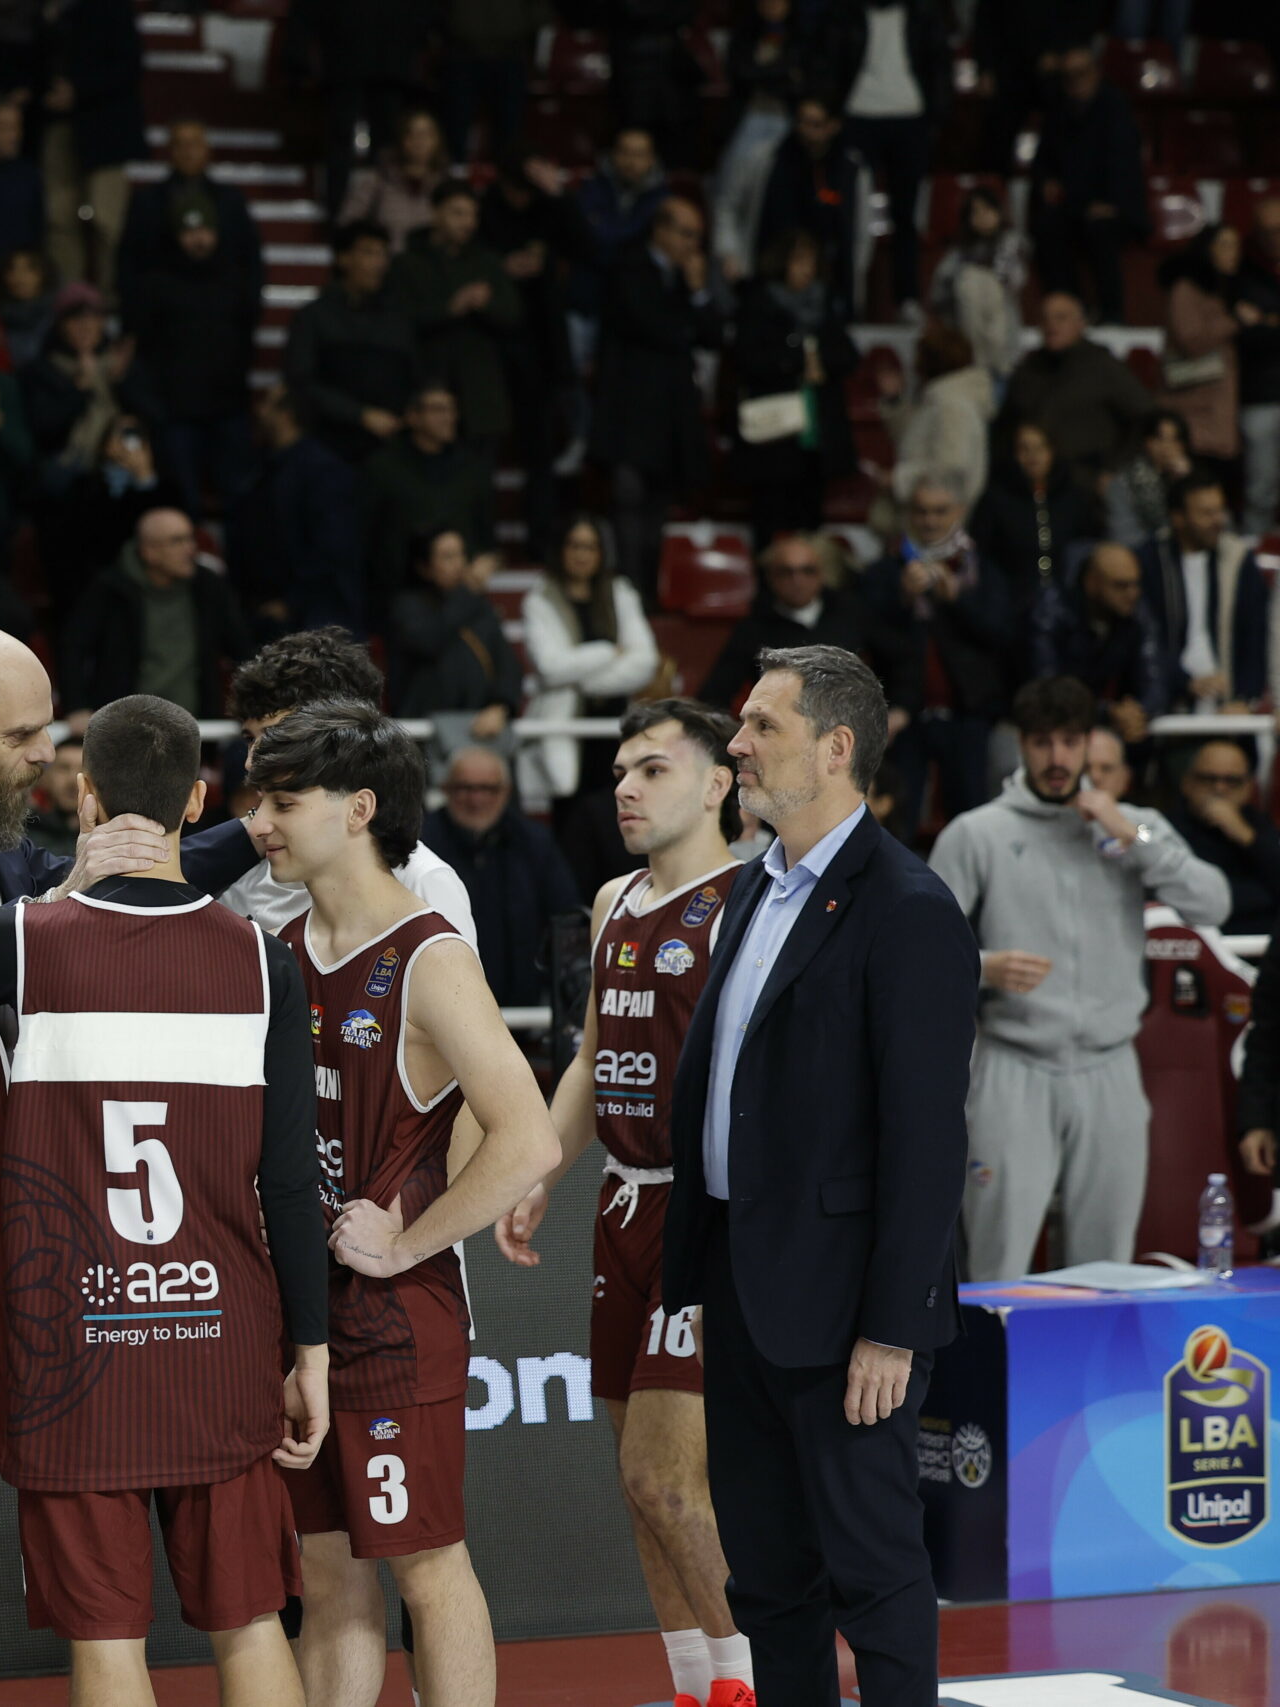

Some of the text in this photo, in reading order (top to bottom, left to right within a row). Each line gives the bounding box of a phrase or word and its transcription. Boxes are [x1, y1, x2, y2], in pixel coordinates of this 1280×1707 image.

[374, 967, 393, 977] LBA
[600, 988, 656, 1018] APANI
[340, 1025, 383, 1043] TRAPANI
[342, 1034, 373, 1048] SHARK
[314, 1064, 342, 1102] ANI
[594, 1048, 657, 1087] a29
[607, 1101, 623, 1115] to
[625, 1101, 655, 1117] build
[102, 1100, 184, 1245] 5
[126, 1260, 220, 1303] a29
[85, 1321, 222, 1346] Energy to build
[646, 1303, 697, 1358] 16
[369, 1427, 401, 1437] TRAPANI
[1179, 1413, 1258, 1453] LBA
[1193, 1456, 1244, 1472] SERIE A
[366, 1453, 409, 1525] 3
[1187, 1489, 1252, 1527] Unipol
